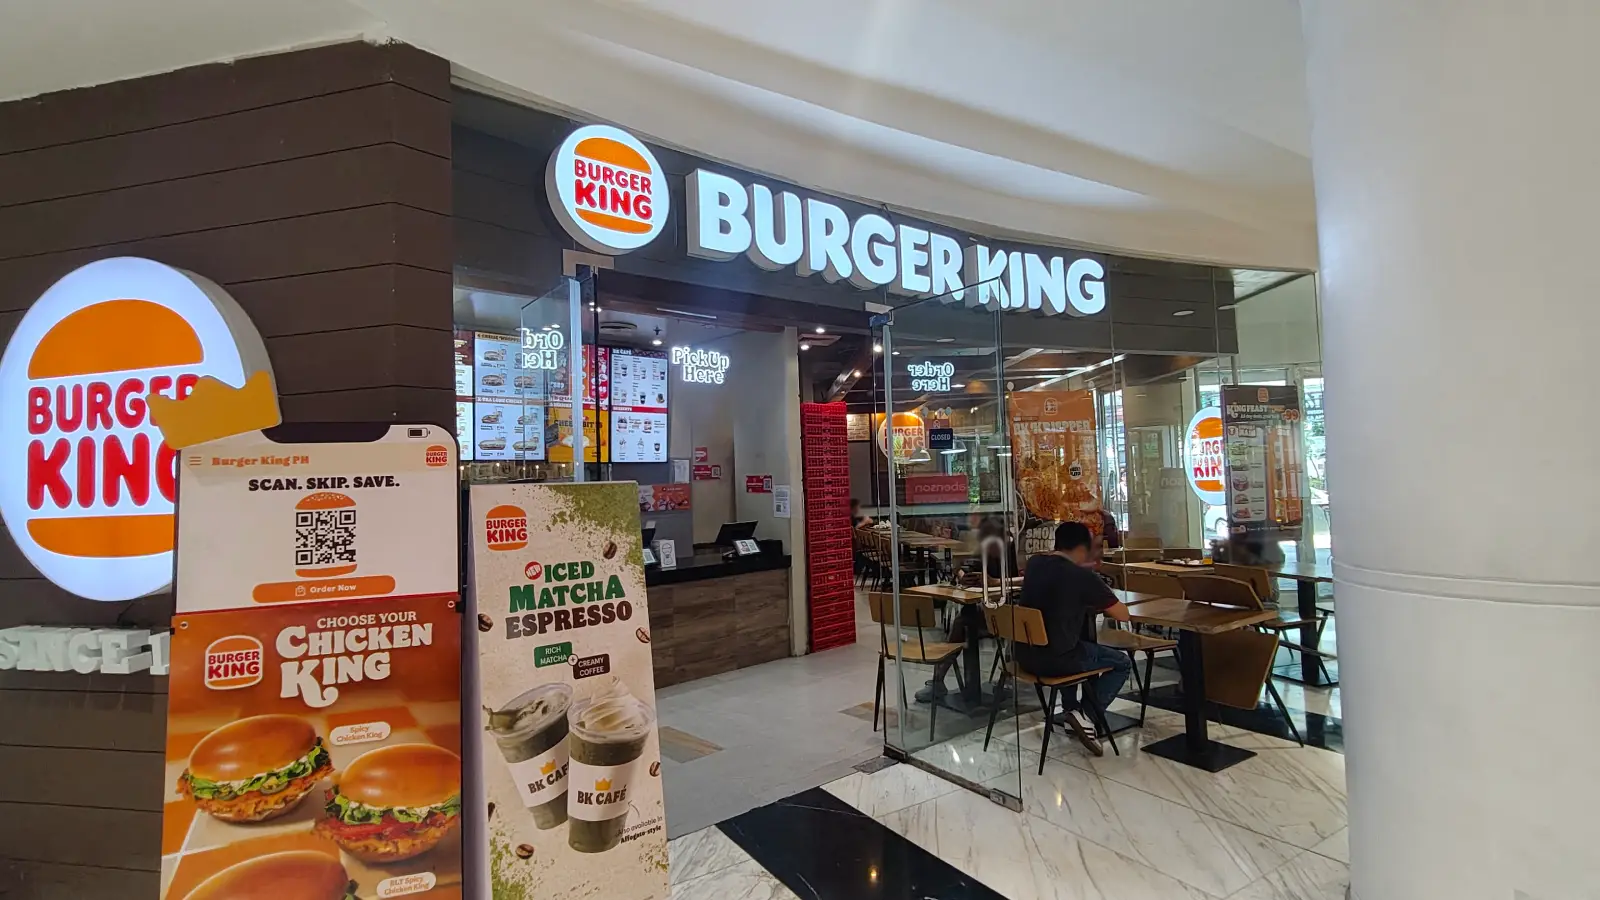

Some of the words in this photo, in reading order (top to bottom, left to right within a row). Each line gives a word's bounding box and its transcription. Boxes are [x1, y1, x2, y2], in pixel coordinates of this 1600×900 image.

[574, 159, 653, 195] BURGER
[574, 179, 653, 220] KING
[693, 168, 964, 301] BURGER
[975, 244, 1106, 315] KING
[683, 364, 724, 384] Here
[930, 433, 951, 441] CLOSED
[211, 456, 258, 468] Burger
[260, 455, 291, 467] King
[293, 455, 310, 465] PH
[248, 477, 302, 491] SCAN.
[306, 476, 350, 490] SKIP.
[353, 475, 400, 488] SAVE.
[486, 518, 527, 530] BURGER
[486, 528, 528, 543] KING
[544, 561, 595, 583] ICED
[310, 584, 336, 594] Order
[337, 584, 356, 592] Now
[509, 574, 625, 613] MATCHA
[317, 615, 376, 629] CHOOSE
[378, 611, 417, 623] YOUR
[505, 601, 633, 639] ESPRESSO
[275, 623, 433, 659] CHICKEN
[208, 651, 260, 665] BURGER
[545, 646, 561, 655] RICH
[540, 654, 568, 665] MATCHA
[578, 657, 604, 668] CREAMY
[208, 661, 260, 680] KING
[579, 666, 605, 677] COFFEE
[280, 652, 391, 708] KING
[528, 779, 545, 794] BK
[577, 790, 594, 805] BK
[595, 785, 627, 805] CAFÉ
